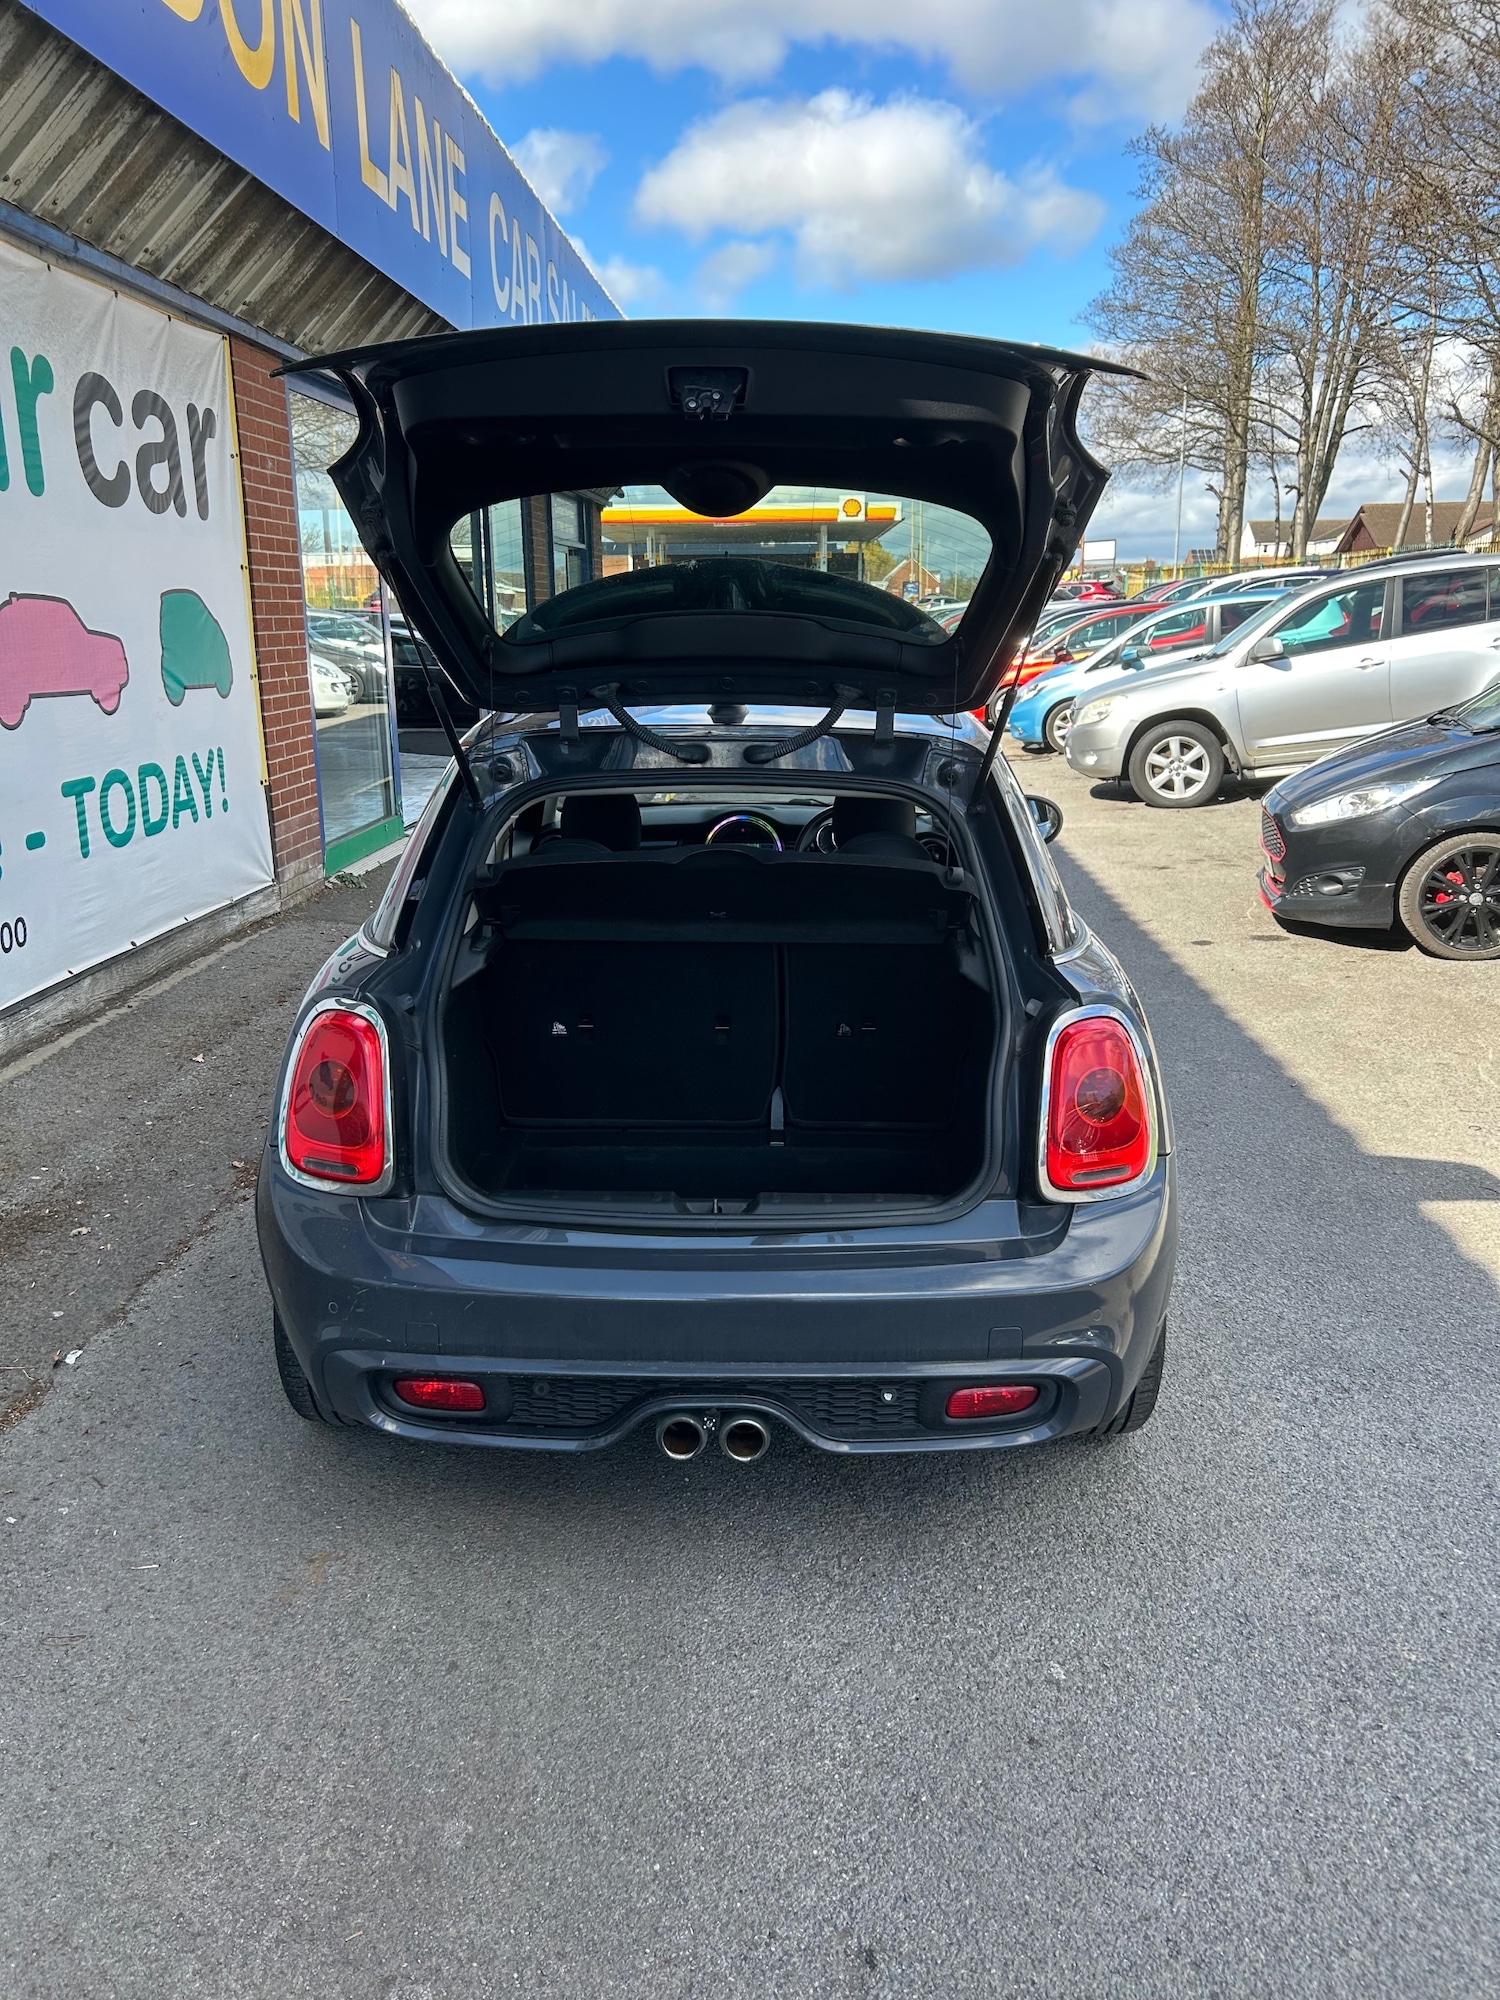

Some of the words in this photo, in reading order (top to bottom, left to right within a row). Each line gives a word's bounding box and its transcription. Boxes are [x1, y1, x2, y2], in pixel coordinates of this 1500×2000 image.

[351, 17, 471, 281] LANE
[489, 191, 542, 325] CAR
[0, 346, 54, 497] r
[73, 371, 216, 521] car
[61, 746, 229, 859] TODAY!
